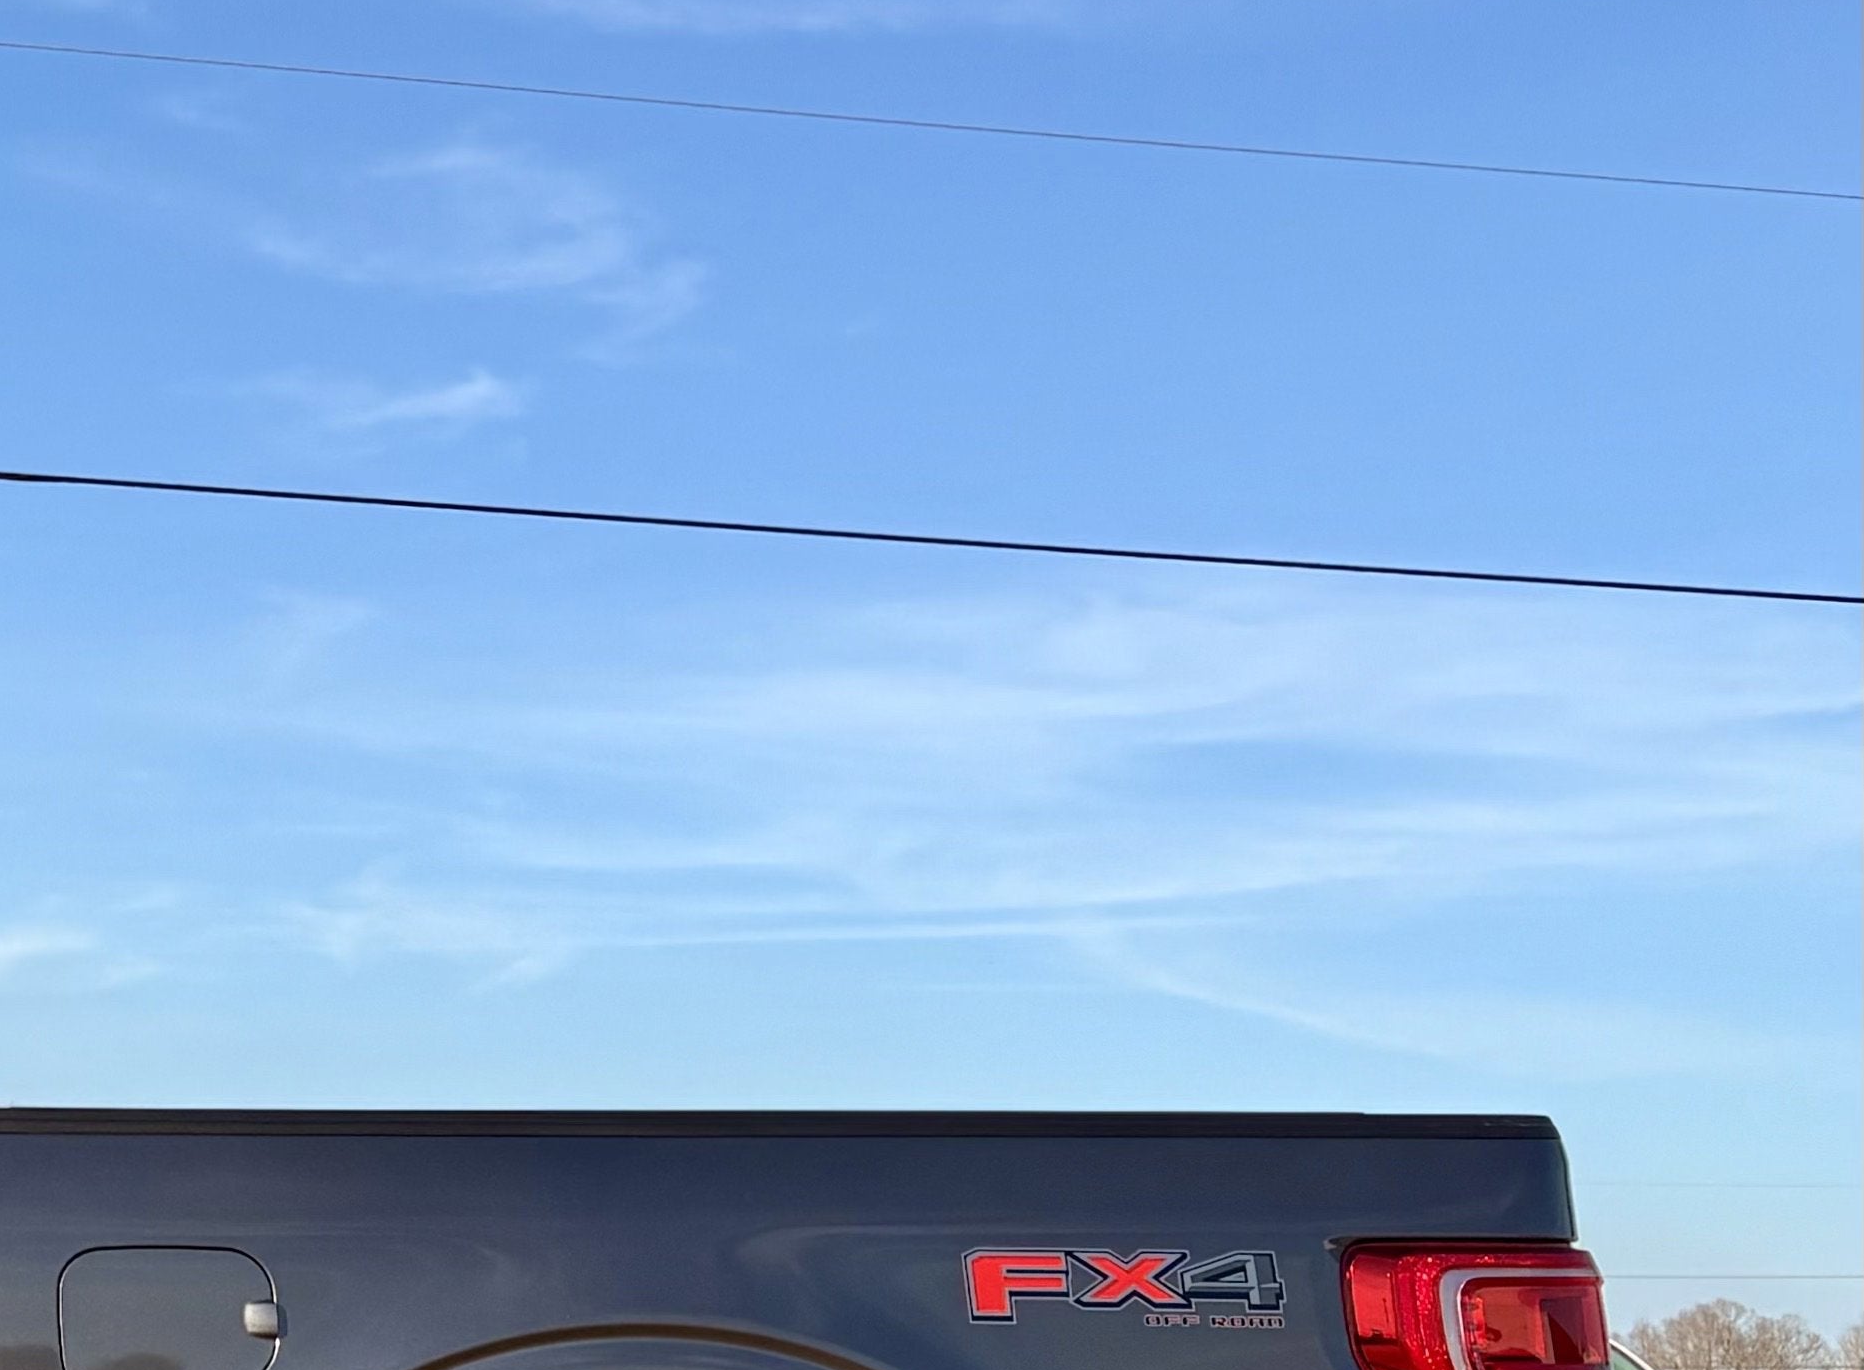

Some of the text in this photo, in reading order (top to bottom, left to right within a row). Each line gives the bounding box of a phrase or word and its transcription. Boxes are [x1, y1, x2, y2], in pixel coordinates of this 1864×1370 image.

[961, 1247, 1287, 1324] FX4
[1144, 1314, 1285, 1329] OFF ROAD
